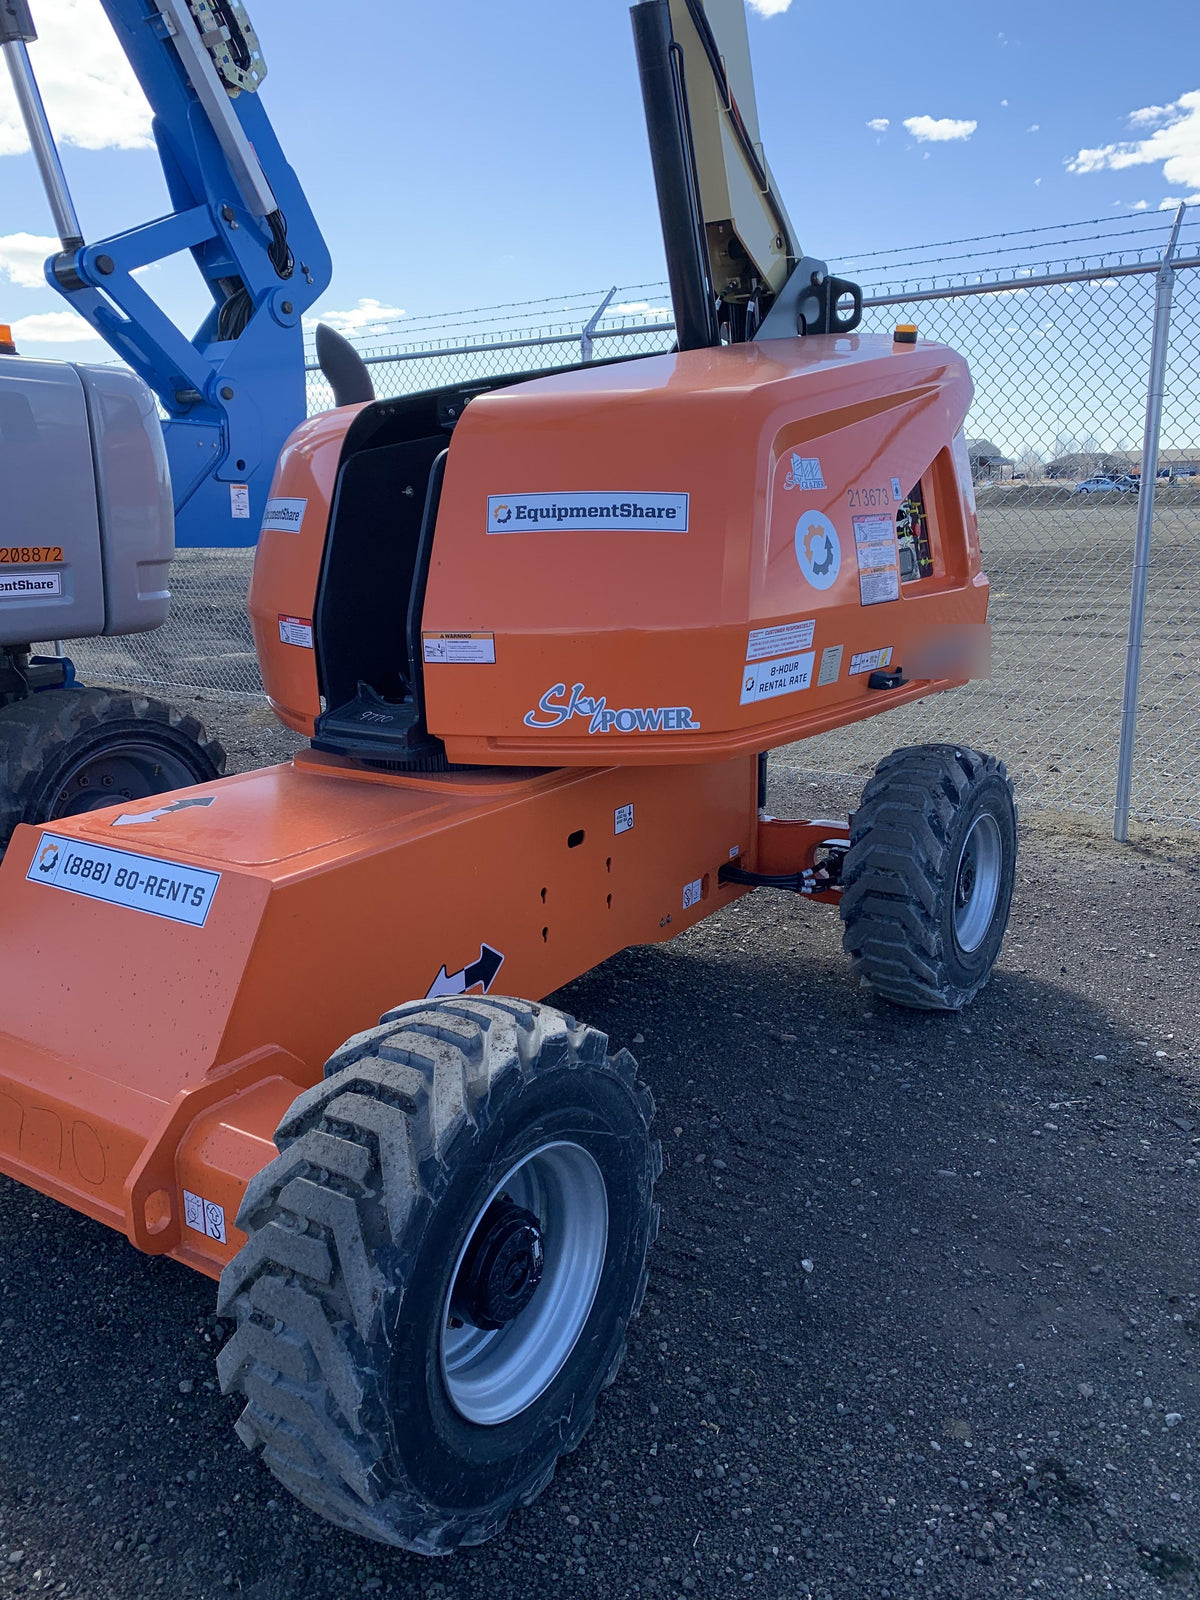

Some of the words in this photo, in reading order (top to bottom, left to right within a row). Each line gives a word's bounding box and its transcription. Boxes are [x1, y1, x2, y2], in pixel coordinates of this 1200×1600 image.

[847, 488, 890, 508] 213673
[515, 503, 677, 523] EquipmentShare
[0, 547, 63, 563] 208872
[770, 661, 799, 676] 8-HOUR
[759, 678, 787, 693] RENTAL
[789, 672, 808, 686] RATE
[63, 853, 112, 885] (888)
[114, 867, 206, 907] 80-RENTS
